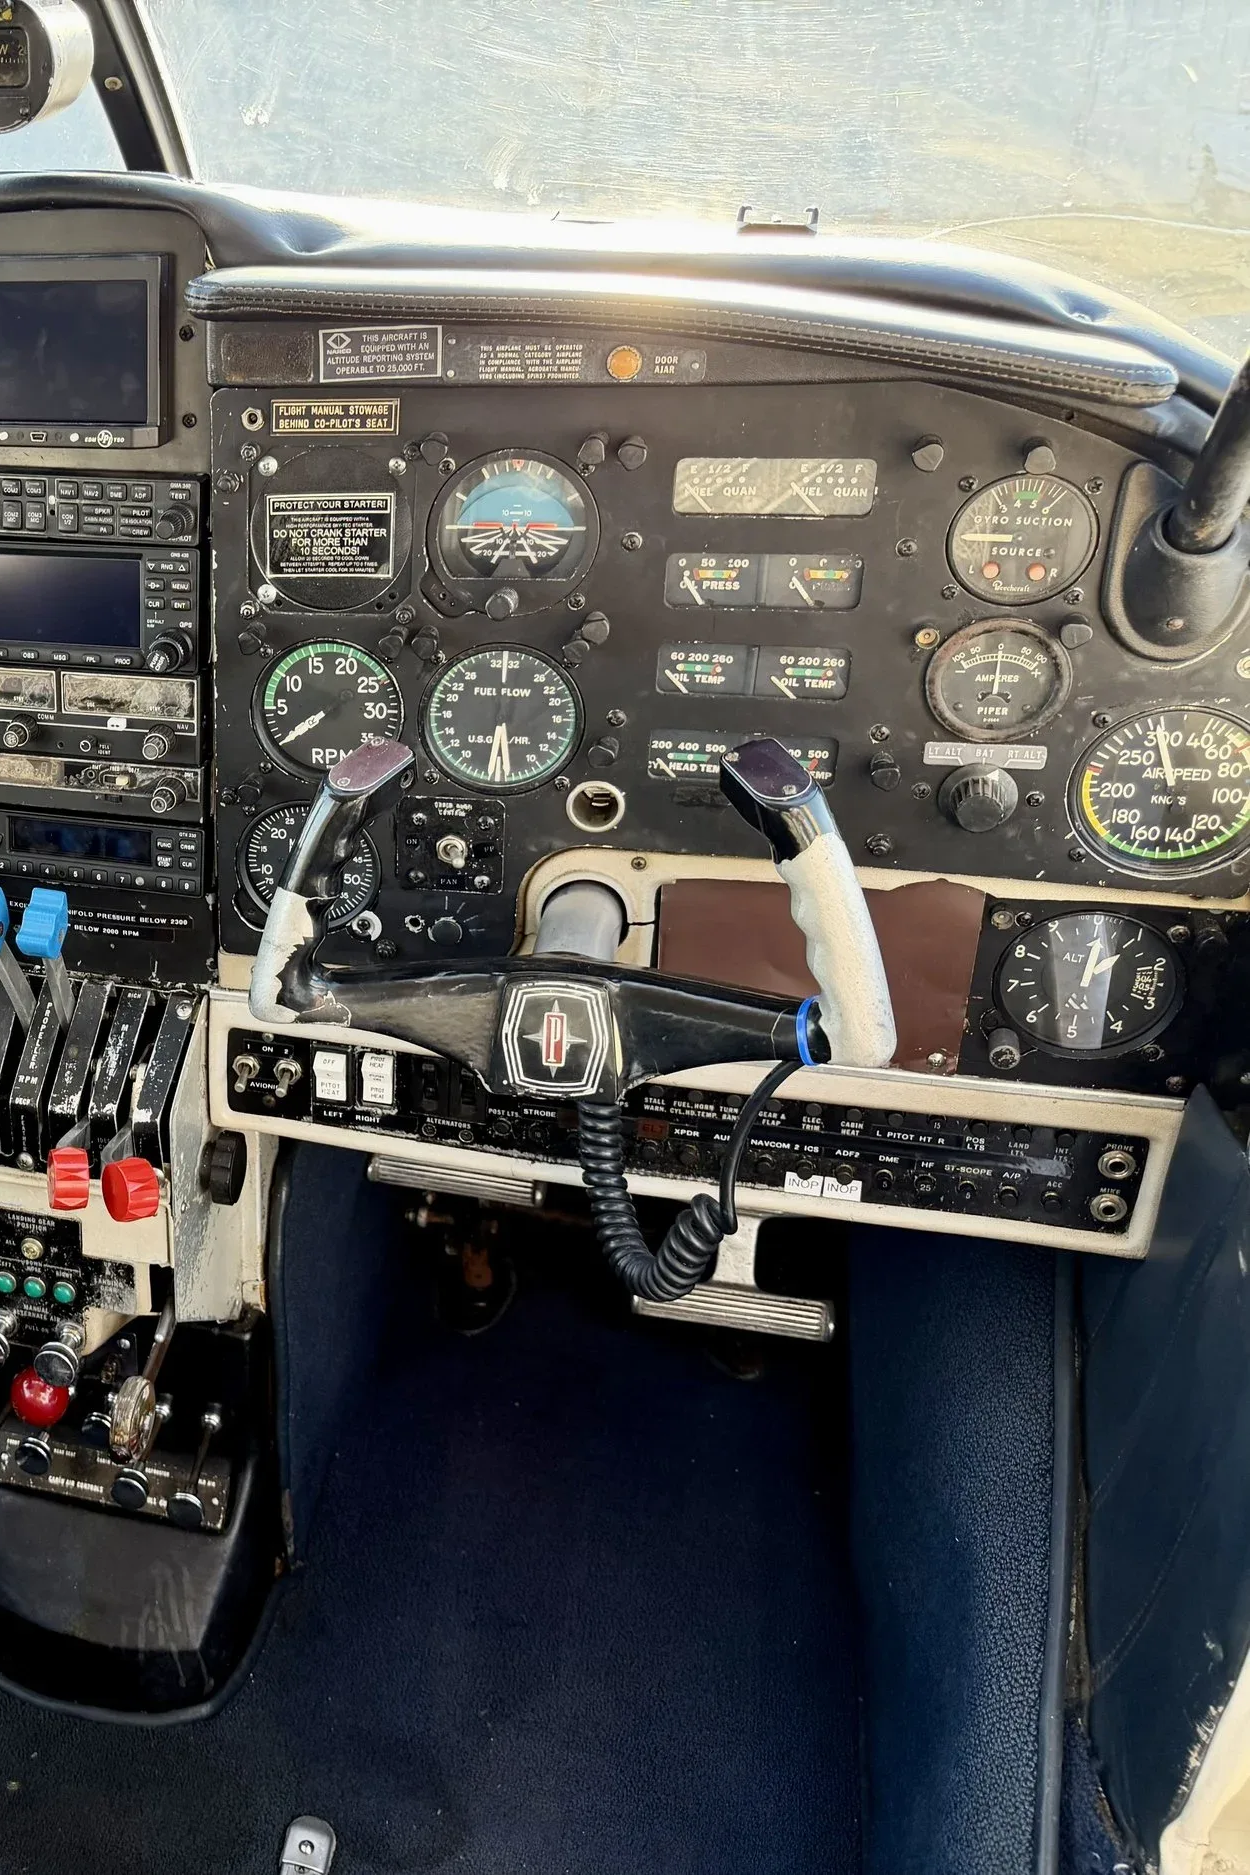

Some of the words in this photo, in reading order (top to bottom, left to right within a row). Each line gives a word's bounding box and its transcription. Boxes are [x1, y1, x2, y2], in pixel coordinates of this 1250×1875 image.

[363, 334, 379, 342] THIS
[381, 333, 417, 342] AIRCRAFT
[420, 332, 428, 340] IS
[360, 344, 396, 353] EQUIPPED
[397, 343, 416, 351] WITH
[327, 356, 360, 365] ALTITUDE
[362, 354, 403, 363] REPORTING
[406, 352, 435, 361] SYSTEM
[655, 356, 678, 365] DOOR
[335, 365, 374, 375] OPERABLE
[376, 364, 385, 373] TO
[387, 363, 413, 373] 25,000
[414, 363, 425, 371] FT.
[654, 365, 675, 375] AJAR
[279, 406, 306, 416] FLIGHT
[311, 406, 344, 415] MANUAL
[349, 405, 388, 415] STOWAGE
[279, 419, 309, 429] BEHIND
[314, 418, 361, 428] CO-PILOT'S
[366, 418, 388, 428] SEAT
[723, 486, 757, 496] QUAN
[833, 487, 868, 497] QUAN
[274, 501, 314, 510] PROTECT
[316, 501, 341, 509] YOUR
[343, 500, 386, 508] STARTER!
[974, 515, 1009, 525] GYRO
[1015, 516, 1073, 527] SUCTION
[273, 530, 287, 538] DO
[289, 529, 309, 538] NOT
[310, 529, 342, 538] CRANK
[344, 528, 387, 537] STARTER
[291, 538, 311, 547] FOR
[313, 538, 341, 547] MORE
[343, 537, 368, 546] THAN
[300, 547, 310, 555] 10
[312, 546, 360, 555] SECONDS!
[991, 547, 1042, 557] SOURCE
[702, 580, 740, 590] PRESS
[309, 657, 324, 674] 15
[335, 658, 358, 675] 20
[286, 675, 302, 692] 10
[673, 673, 689, 682] OIL
[694, 674, 726, 685] TEMP
[780, 677, 799, 687] OIL
[804, 678, 836, 689] TEMP
[975, 674, 1020, 683] AMPERES
[357, 677, 379, 693] 25
[474, 687, 497, 696] FUEL
[501, 688, 532, 697] FLOW
[277, 699, 288, 715] 5
[364, 702, 387, 719] 30
[977, 706, 1009, 716] PIPER
[1186, 731, 1213, 749] 40
[929, 746, 940, 755] LT
[944, 747, 963, 756] ALT
[975, 749, 995, 758] BAT
[1007, 750, 1020, 759] RT
[1024, 750, 1043, 759] ALT
[1205, 744, 1232, 760] 60
[1118, 750, 1155, 766] 250
[669, 762, 698, 773] HEAD
[1217, 763, 1243, 778] 80
[1100, 782, 1136, 798] 200
[1212, 788, 1243, 804] 100
[1112, 809, 1141, 824] 180
[1191, 814, 1221, 830] 120
[1130, 825, 1160, 841] 160
[1165, 827, 1196, 843] 140
[97, 912, 136, 922] PRESSURE
[140, 916, 167, 925] BELOW
[74, 924, 99, 932] BELOW
[102, 927, 119, 935] 2000
[122, 929, 140, 937] RPM
[18, 1075, 38, 1085] RPM
[644, 1097, 665, 1105] STALL
[523, 1108, 557, 1117] STROBE
[643, 1104, 667, 1113] WARN.
[323, 1110, 344, 1118] LEFT
[355, 1114, 382, 1124] RIGHT
[758, 1110, 779, 1119] GEAR
[426, 1117, 471, 1130] ALTERNATORS
[802, 1123, 820, 1131] TRIM
[840, 1121, 864, 1130] CABIN
[674, 1128, 700, 1138] XPDR
[841, 1128, 859, 1136] HEAT
[886, 1131, 915, 1141] PITOT
[919, 1135, 933, 1144] HT
[938, 1137, 945, 1145] R
[966, 1136, 985, 1145] POS
[750, 1138, 791, 1150] NAVCOM
[804, 1145, 819, 1153] ICS
[967, 1143, 985, 1152] LTS
[1008, 1141, 1030, 1150] LAND
[1106, 1143, 1134, 1152] PHONE
[835, 1149, 860, 1158] ADF2
[878, 1155, 900, 1164] DME
[921, 1161, 935, 1169] HF
[944, 1164, 993, 1176] ST-SCOPE
[1003, 1171, 1021, 1180] A/P
[788, 1178, 820, 1190] INOP
[827, 1183, 859, 1195] INOP
[1100, 1187, 1121, 1195] MIKE
[7, 1214, 37, 1225] LANDING
[38, 1219, 55, 1227] GEAR
[16, 1222, 47, 1232] POSITION
